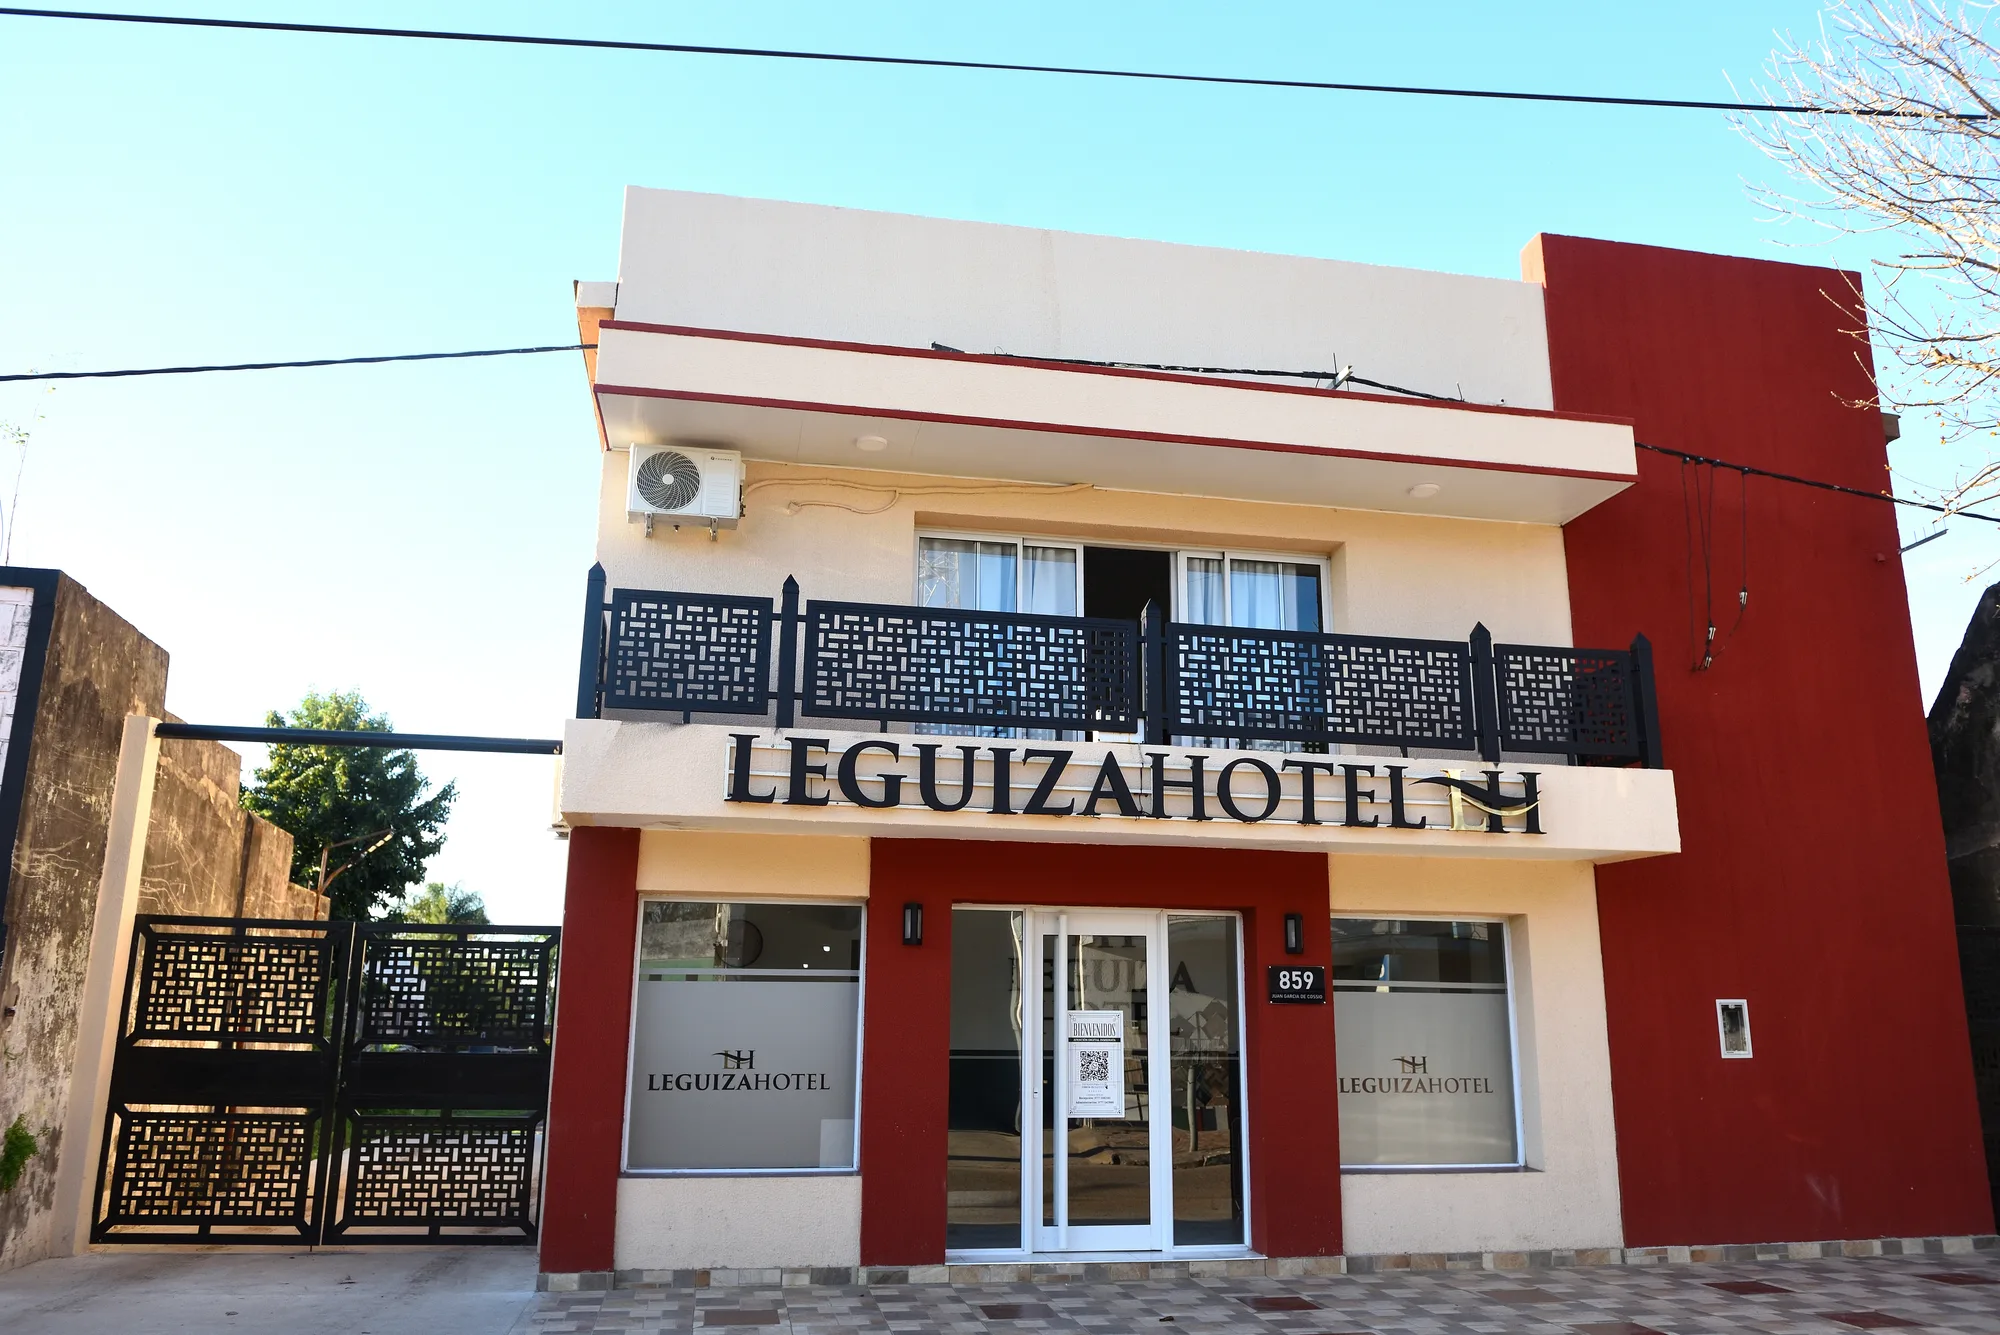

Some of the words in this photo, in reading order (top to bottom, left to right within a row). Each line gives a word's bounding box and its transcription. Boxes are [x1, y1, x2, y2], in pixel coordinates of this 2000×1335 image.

[724, 733, 1426, 829] LEGUIZAHOTEL
[1279, 970, 1314, 990] 859
[1073, 1022, 1116, 1037] BIENVENIDOS
[647, 1073, 831, 1091] LEGUIZAHOTEL
[1338, 1077, 1494, 1094] LEGUIZAHOTEL
